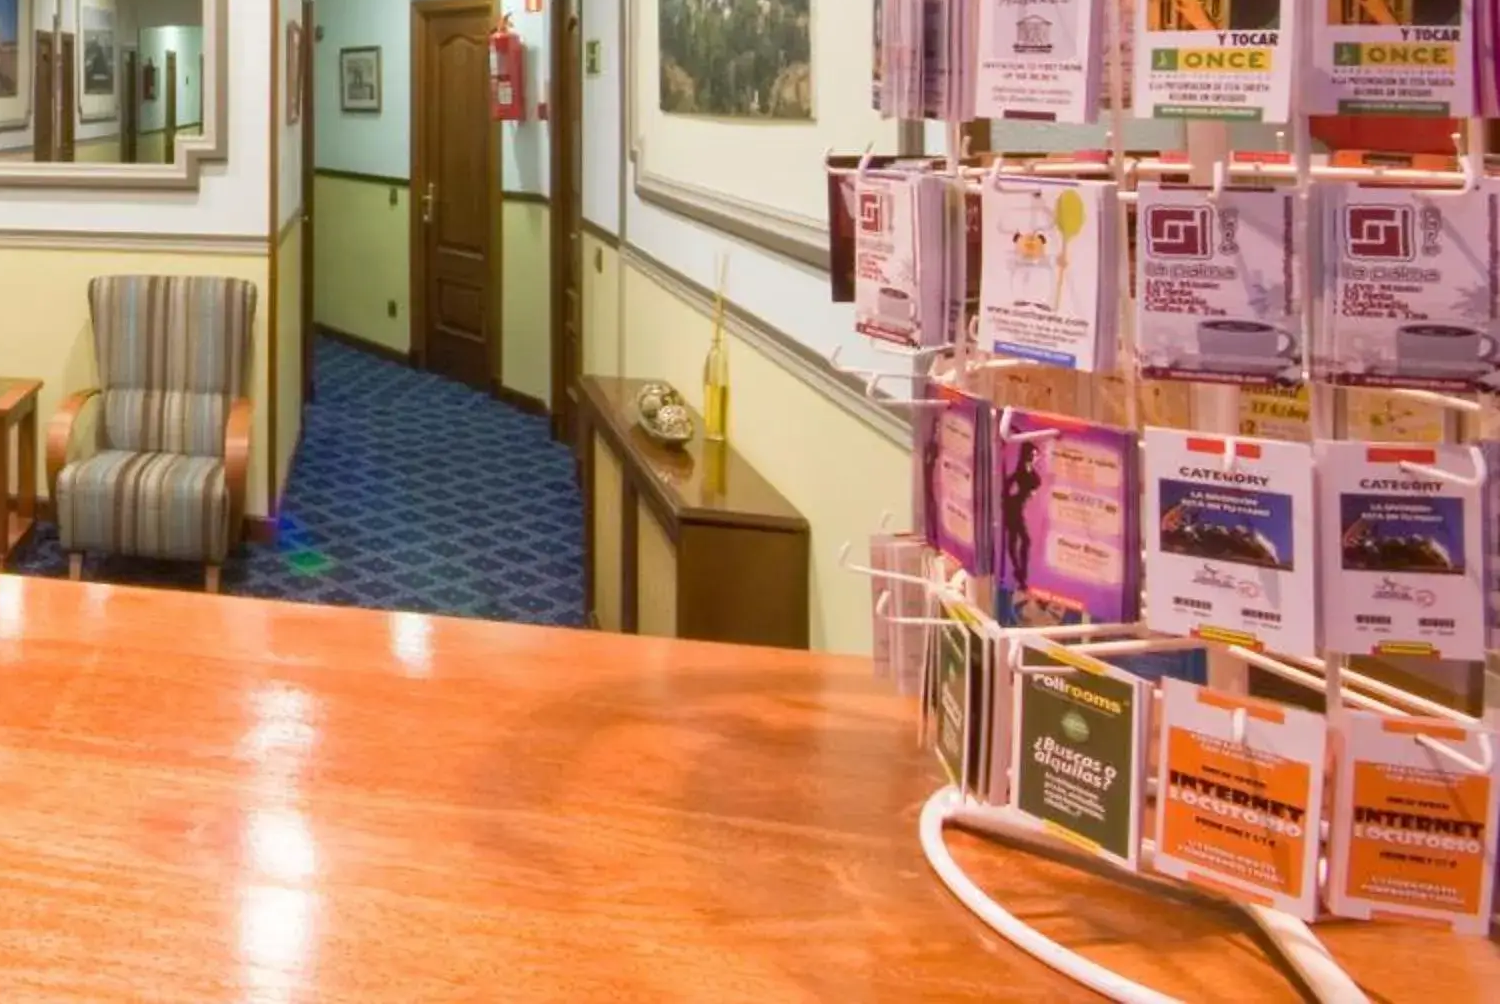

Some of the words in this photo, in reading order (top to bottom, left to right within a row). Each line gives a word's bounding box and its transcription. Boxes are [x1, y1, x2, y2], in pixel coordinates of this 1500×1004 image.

[1217, 33, 1226, 46] Y
[1231, 33, 1279, 46] TOCAR
[1400, 28, 1410, 41] Y
[1415, 28, 1460, 42] TOCAR
[1183, 50, 1266, 69] ONCE
[1367, 46, 1448, 65] ONCE
[1359, 478, 1444, 492] CATEGORY
[1033, 749, 1114, 791] alquilas?
[1169, 769, 1305, 824] INTERNET
[1168, 783, 1302, 838] LOCUTORIO
[1354, 805, 1485, 838] INTERNET
[1353, 824, 1481, 854] LOCUTORIO
